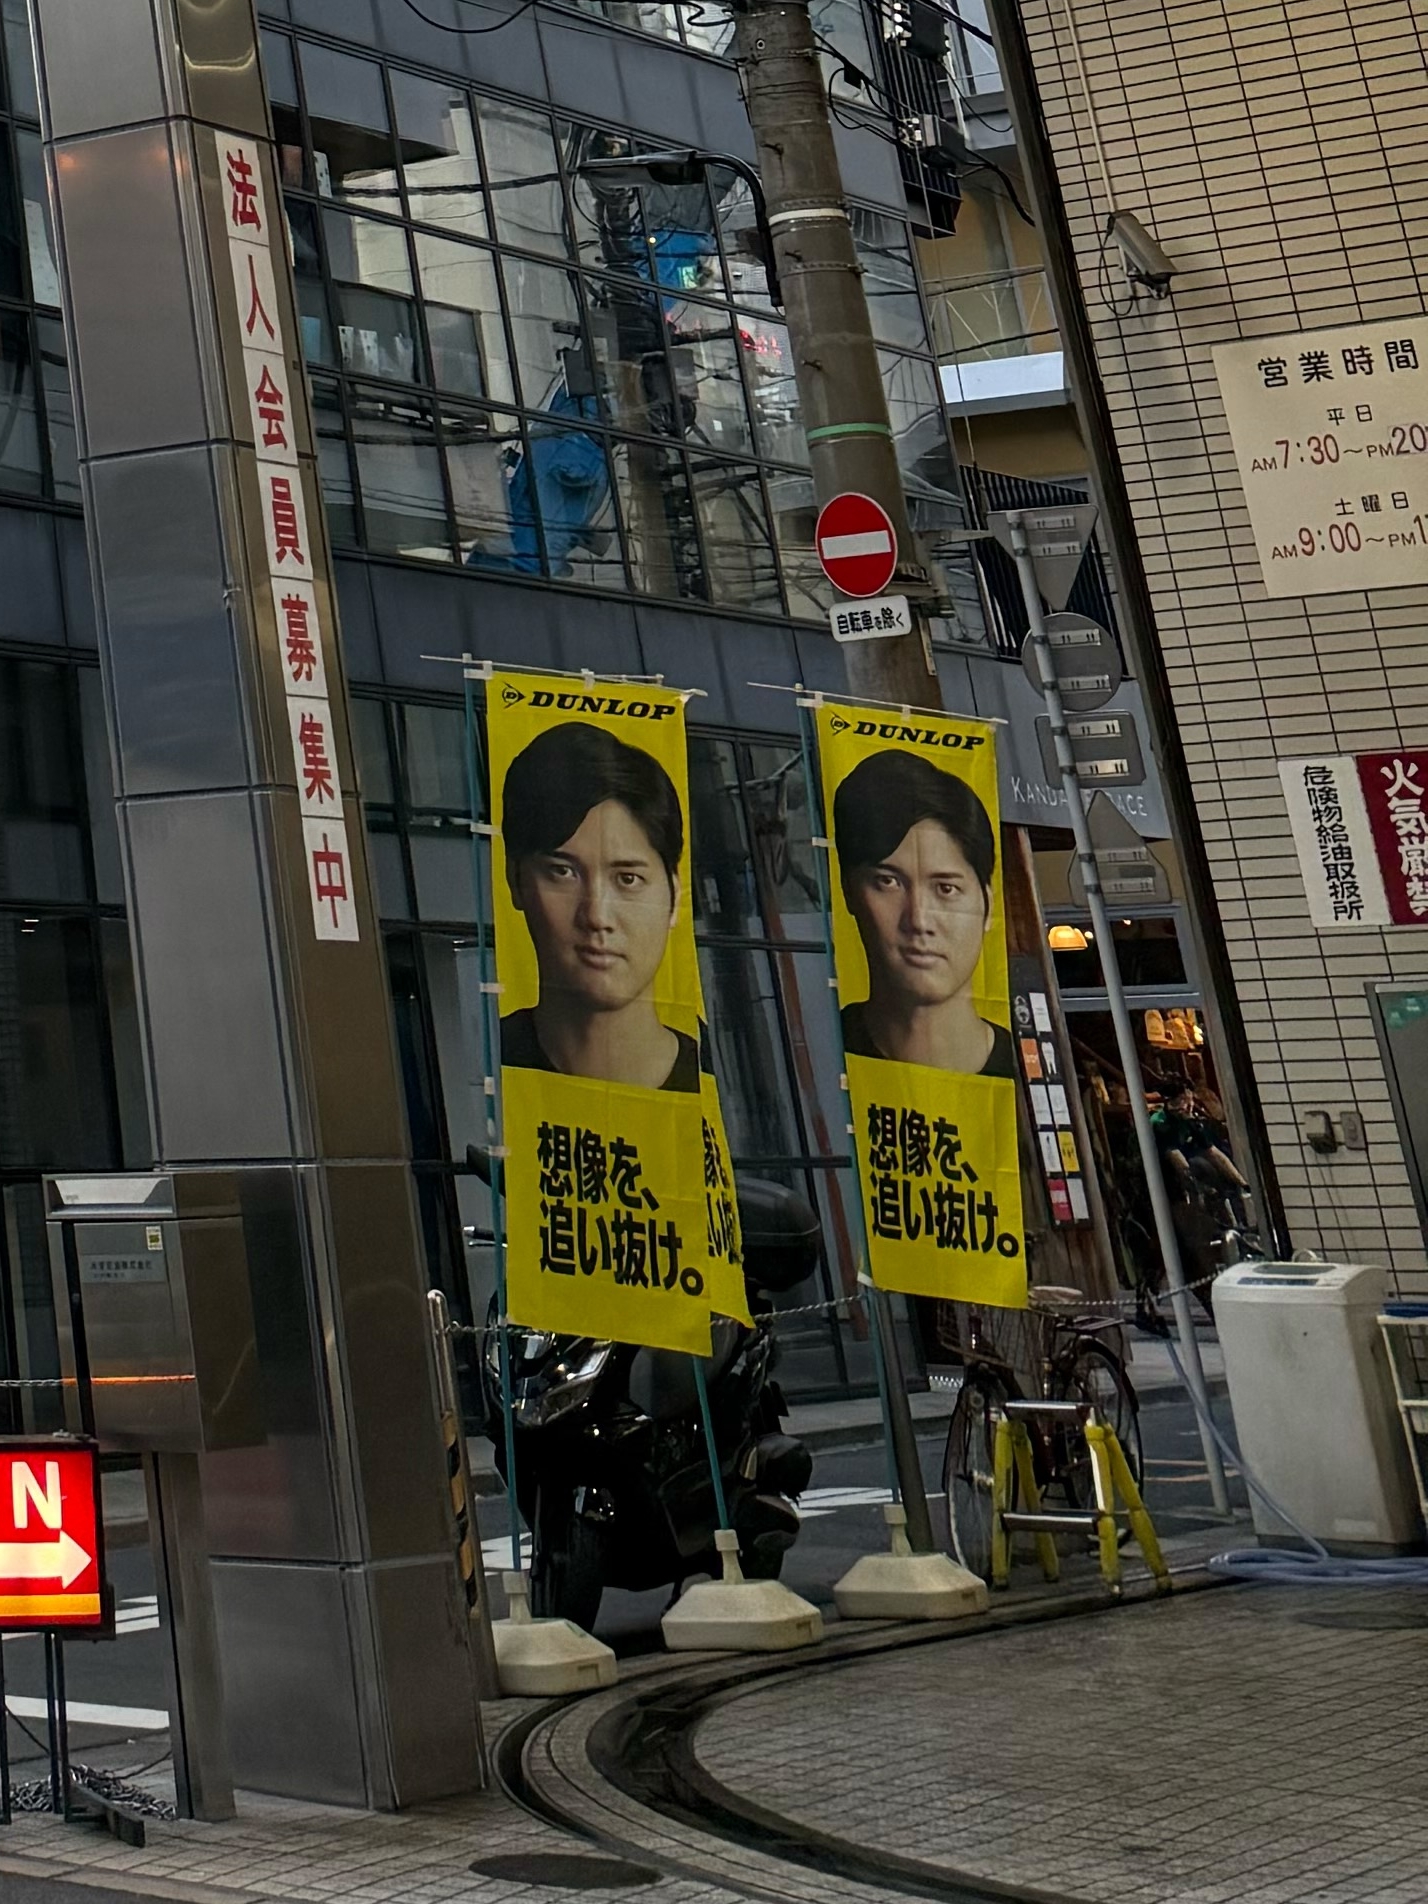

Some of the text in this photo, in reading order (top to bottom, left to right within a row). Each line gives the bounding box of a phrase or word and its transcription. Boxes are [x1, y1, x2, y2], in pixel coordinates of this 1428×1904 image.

[1257, 338, 1420, 389] 営業時間
[1326, 404, 1373, 426] 平日
[1334, 491, 1409, 516] 土曜日
[225, 149, 351, 931] 法人会員募集中
[837, 607, 904, 634] 自転車を除く
[527, 689, 676, 723] DUNLOP
[852, 720, 985, 751] DUNLOP
[1303, 765, 1365, 921] 危険物給油取扱所
[537, 1121, 660, 1211] 想像を、
[867, 1102, 978, 1183] 想像を、
[539, 1199, 704, 1297] 追い抜け。
[870, 1179, 1020, 1260] 追い抜け。
